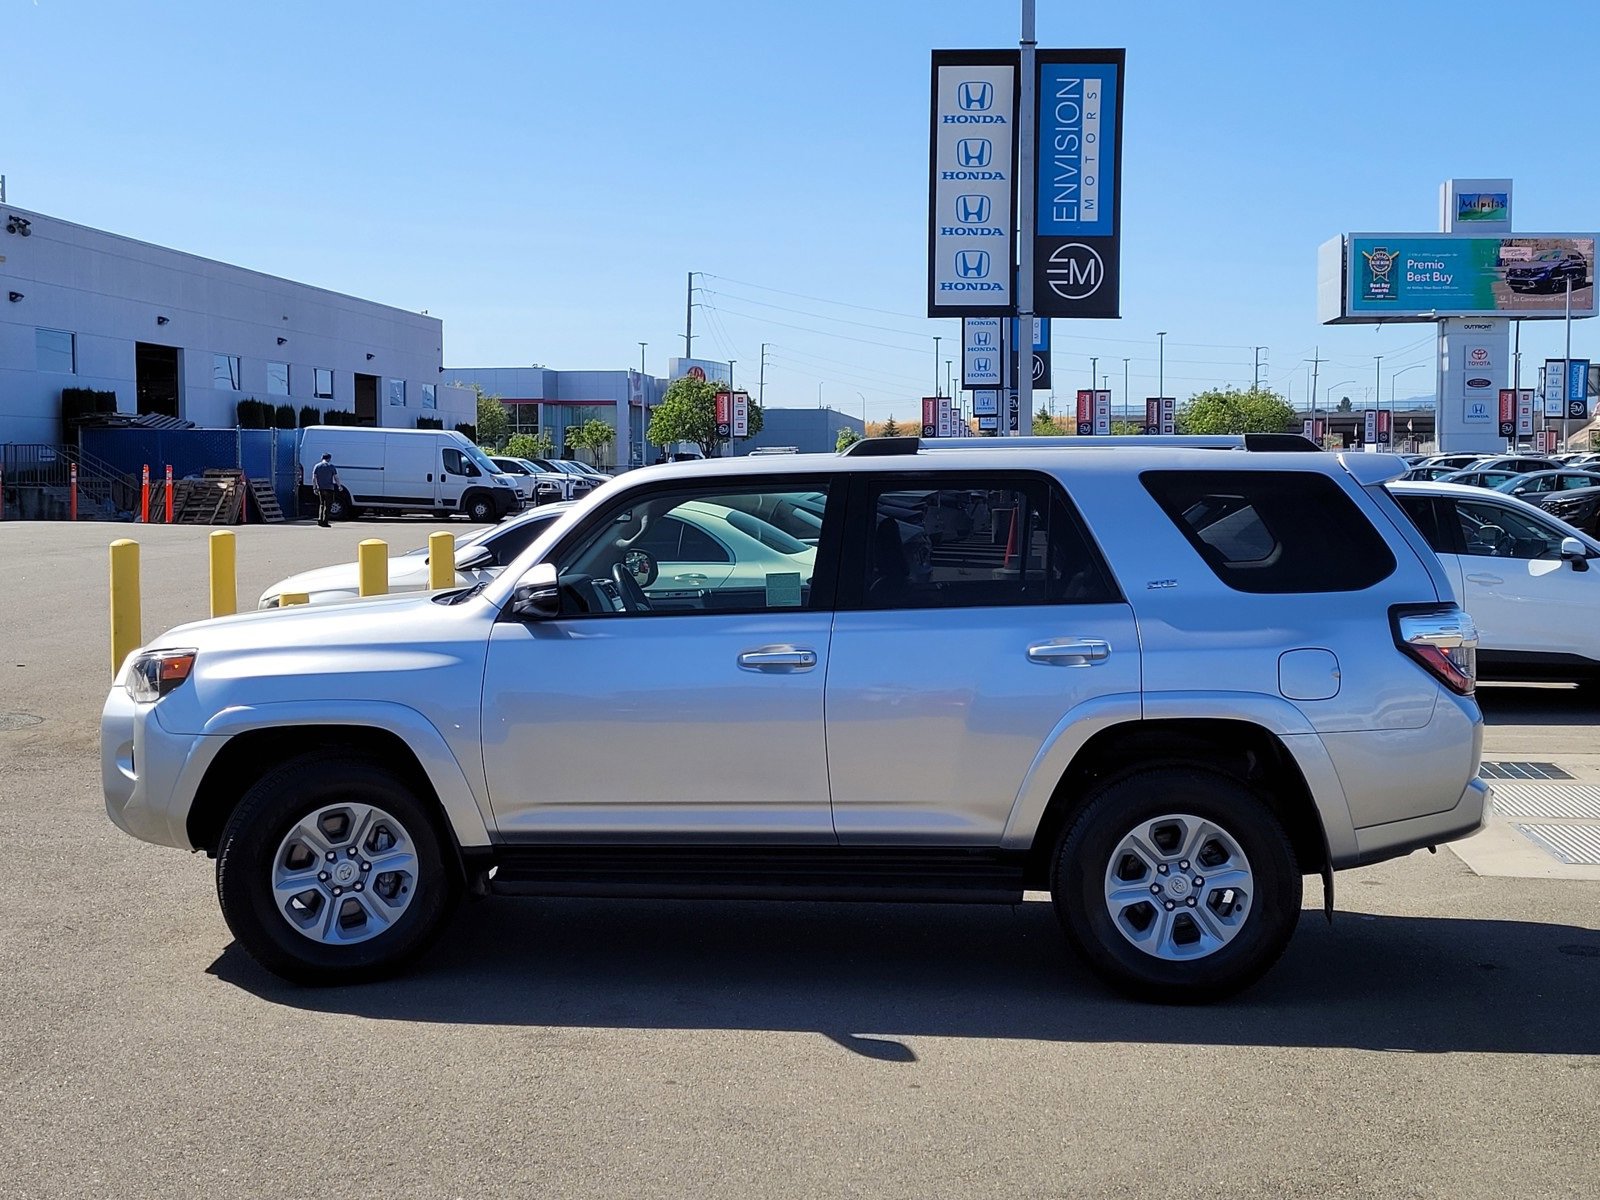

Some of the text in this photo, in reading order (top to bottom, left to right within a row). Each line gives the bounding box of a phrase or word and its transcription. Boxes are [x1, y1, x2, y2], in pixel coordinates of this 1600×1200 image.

[942, 114, 1007, 124] HONDA
[1053, 78, 1080, 222] ENVISION
[1084, 92, 1097, 210] MOTORS
[941, 171, 1006, 180] HONDA
[1460, 194, 1505, 213] Milpitas
[940, 227, 1004, 236] HONDA
[1407, 259, 1444, 269] Premio
[1407, 272, 1453, 284] Best Buy
[940, 282, 1004, 291] HONDA
